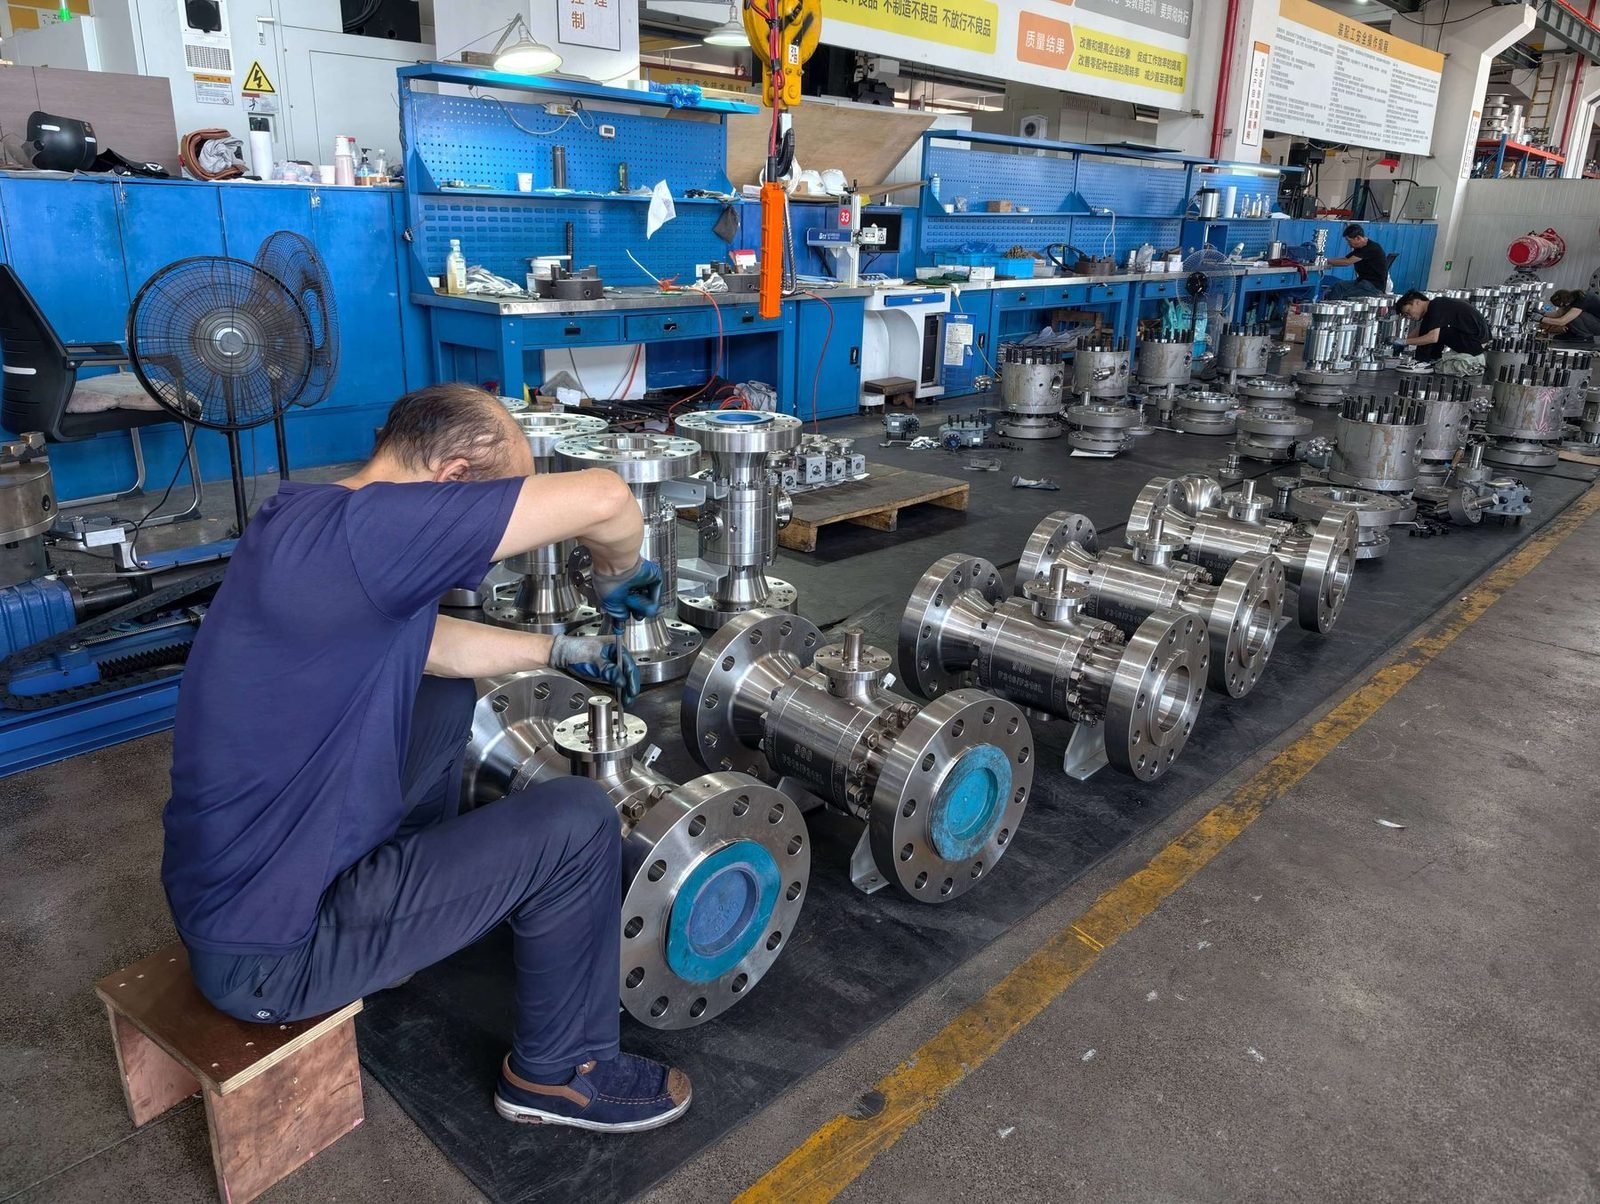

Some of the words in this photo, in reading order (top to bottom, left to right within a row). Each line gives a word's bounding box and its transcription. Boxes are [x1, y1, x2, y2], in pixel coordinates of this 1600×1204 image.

[942, 8, 991, 37] 不放行不良品
[1026, 30, 1065, 55] 质量结果
[840, 211, 850, 223] 33
